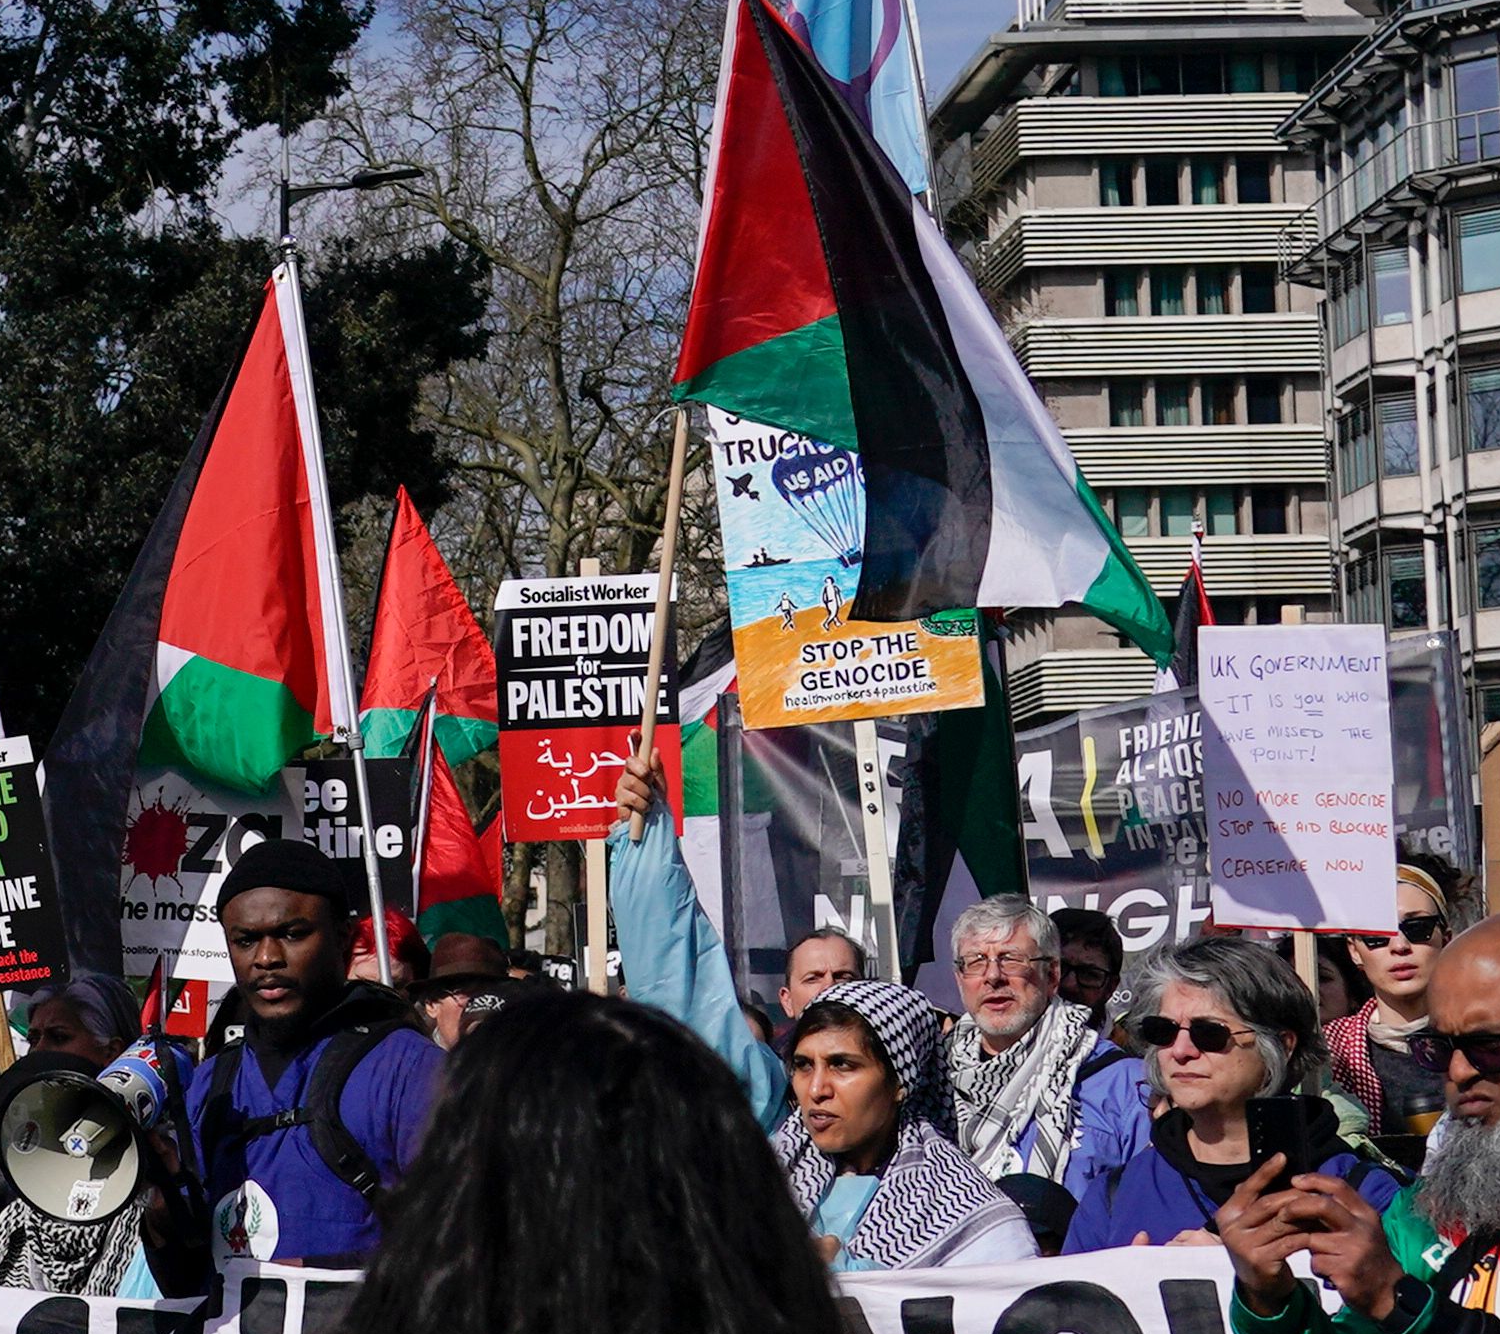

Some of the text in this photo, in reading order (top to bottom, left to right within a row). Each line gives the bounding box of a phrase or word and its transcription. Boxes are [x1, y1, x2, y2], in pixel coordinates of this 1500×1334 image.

[782, 456, 848, 492] US AID
[520, 584, 650, 604] Socialist Worker
[511, 612, 658, 658] FREEDOM
[802, 632, 918, 664] STOP THE
[575, 655, 600, 676] for
[800, 658, 927, 692] GENOCIDE
[1210, 653, 1382, 680] UK GOVERNMENT
[784, 679, 937, 709] healthworkers4palestine
[1268, 693, 1284, 709] IS
[1336, 691, 1369, 704] WHO
[1119, 711, 1202, 759] FRIEND
[1218, 726, 1374, 744] HAVE MISSED THE
[1251, 743, 1317, 763] POINT!
[1119, 779, 1204, 821] PEACE
[1216, 789, 1387, 811] NO MORE GENOCIDE
[1219, 819, 1255, 838] STOP
[1263, 820, 1288, 835] THE
[1296, 820, 1321, 834] AID
[1328, 820, 1389, 839] BLOCKADE
[1221, 857, 1365, 880] CEASEFIRE NOW
[18, 949, 39, 966] the
